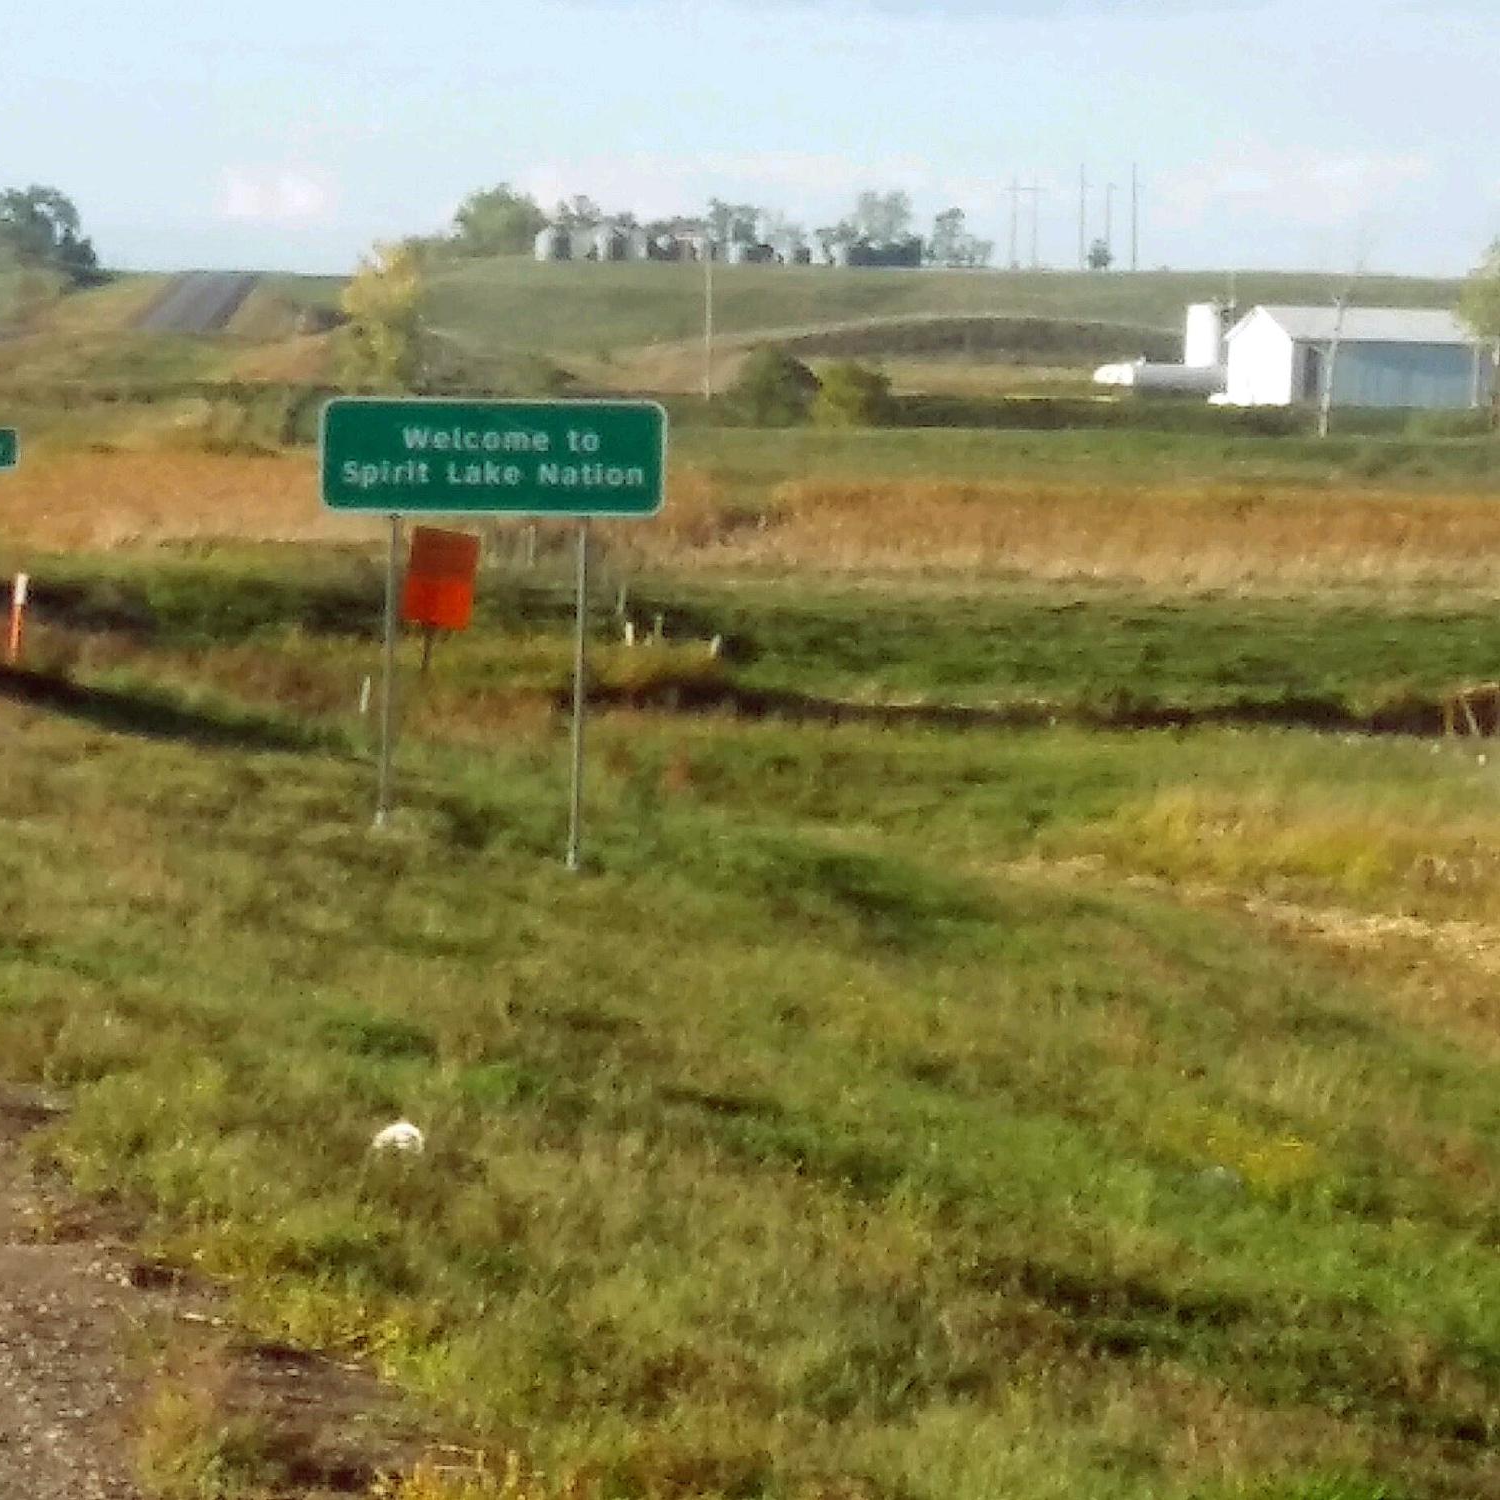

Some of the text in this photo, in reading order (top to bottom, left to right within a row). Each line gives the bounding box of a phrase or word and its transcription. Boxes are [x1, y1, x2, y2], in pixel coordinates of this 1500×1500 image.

[403, 427, 600, 452] Welcome to
[342, 460, 644, 488] Spirit Lake Nation
